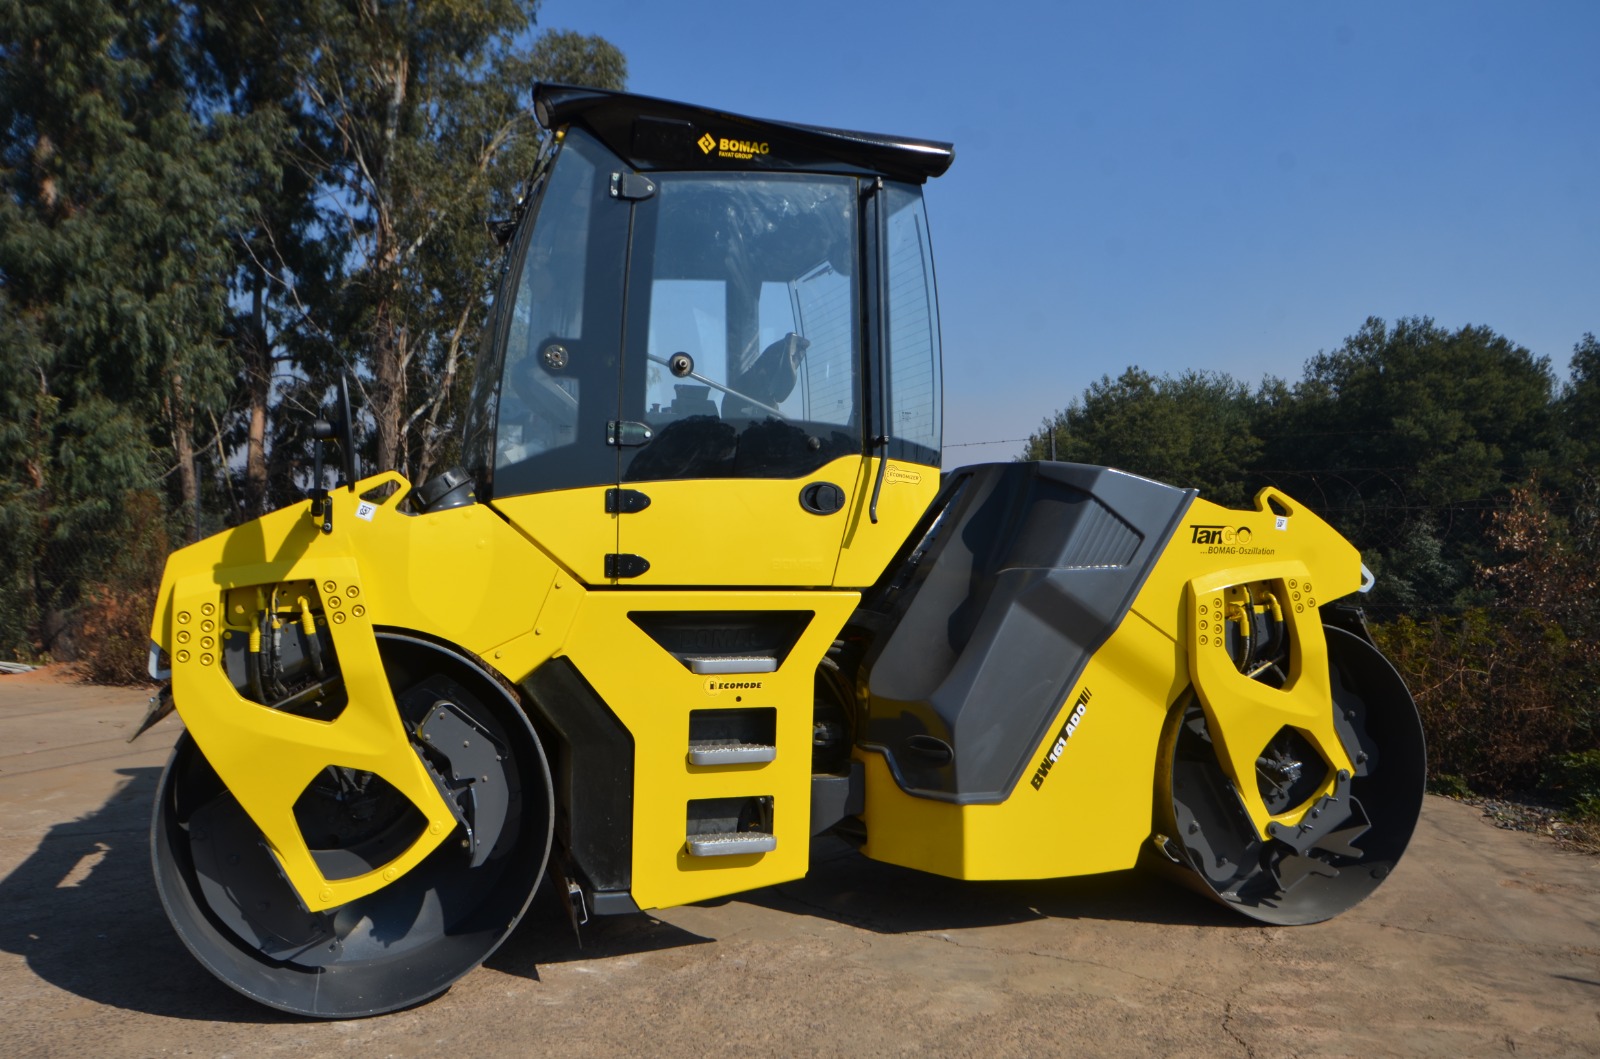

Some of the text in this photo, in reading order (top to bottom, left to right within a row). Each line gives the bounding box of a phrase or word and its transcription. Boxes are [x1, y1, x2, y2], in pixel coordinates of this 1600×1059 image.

[719, 138, 769, 154] BOMAG
[890, 472, 919, 480] ECONOMIZER
[718, 682, 762, 690] ECOMODE
[1065, 703, 1087, 738] ADO
